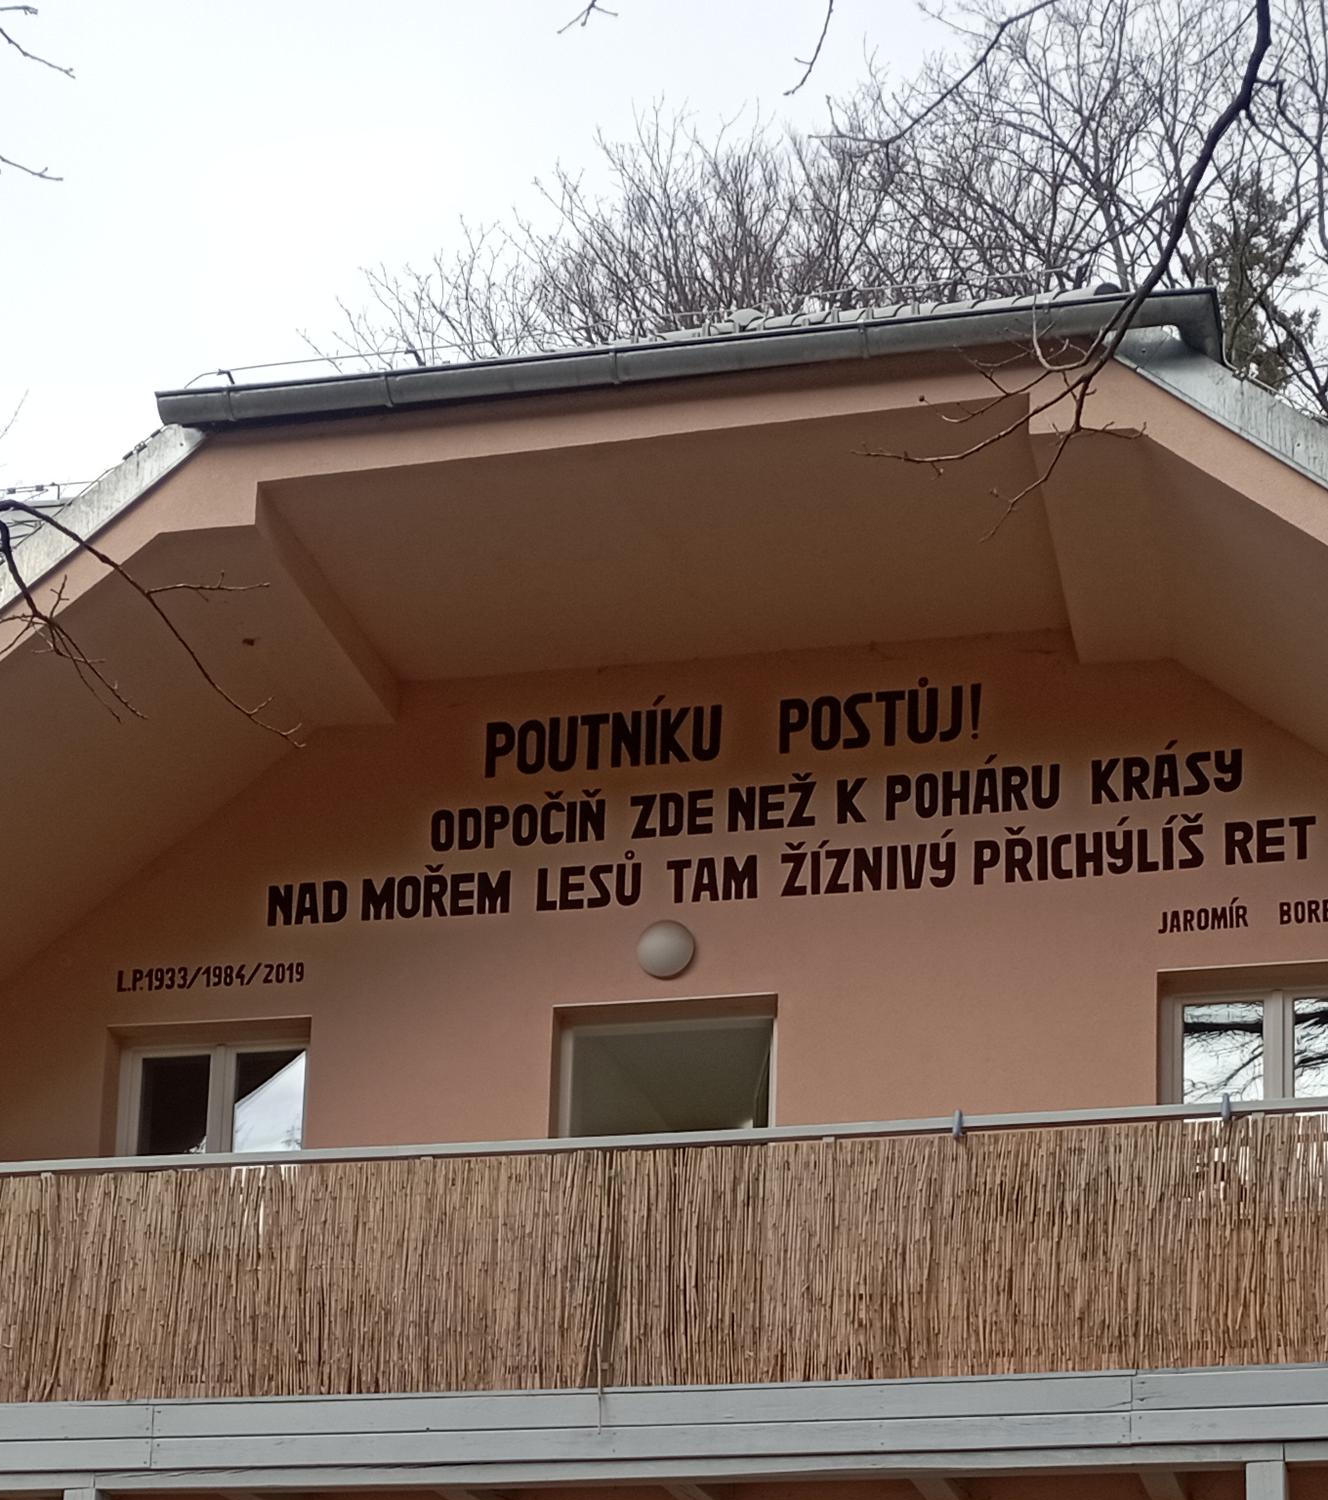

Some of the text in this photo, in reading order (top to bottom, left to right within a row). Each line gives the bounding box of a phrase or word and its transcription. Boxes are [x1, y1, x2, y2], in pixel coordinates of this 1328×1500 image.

[484, 677, 983, 778] POUTNÍKU POSTŮJ!
[430, 740, 1243, 852] ODPOČIŇ ZDE NEŽ K POHÁRU KRÁSY
[267, 812, 1317, 927] NAD MOŘEM LESŮ TAM ŽÍZNIVÝ PŘICHÝLÍŠ RET
[1157, 897, 1249, 934] JAROMÍR
